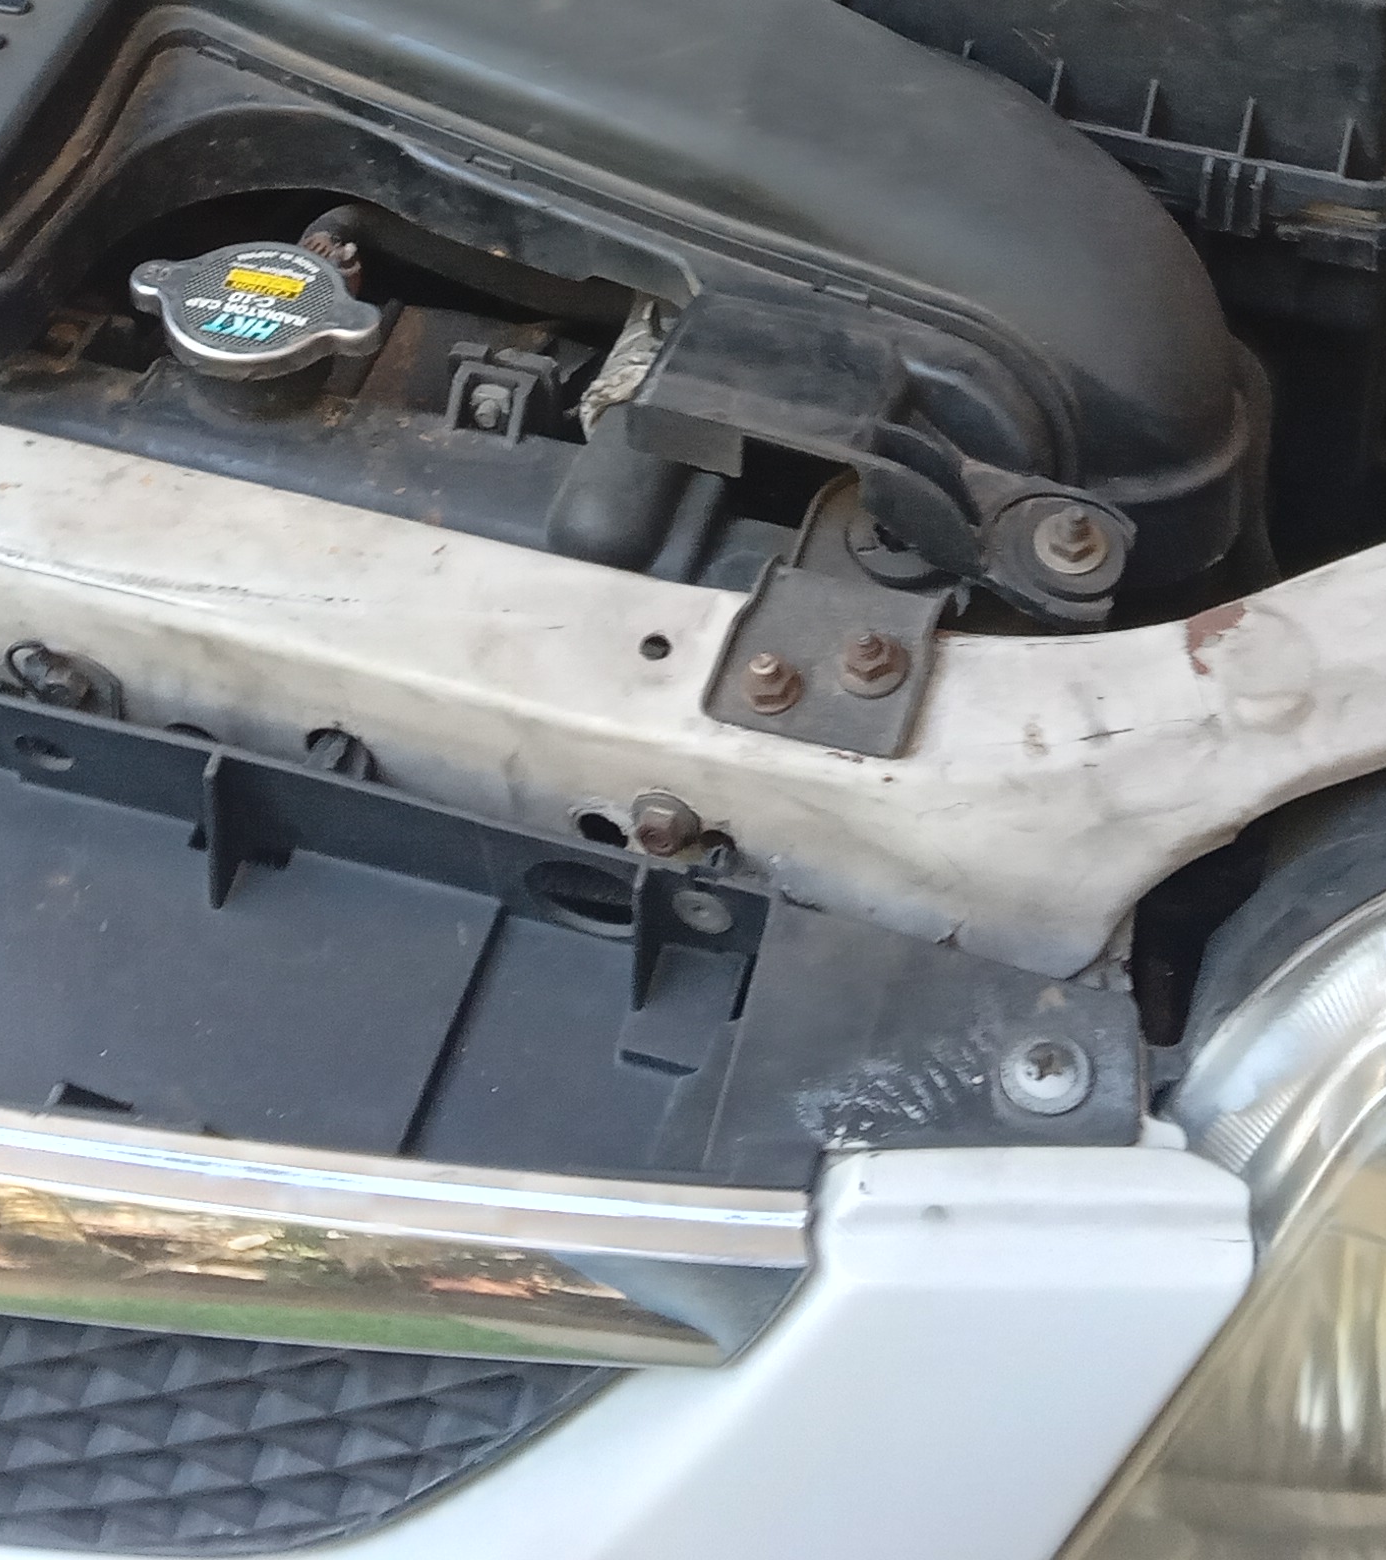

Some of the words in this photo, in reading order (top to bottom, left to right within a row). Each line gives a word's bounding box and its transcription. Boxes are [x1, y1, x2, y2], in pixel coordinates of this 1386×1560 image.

[184, 297, 223, 310] CAP
[222, 302, 309, 326] RADIATOR
[198, 313, 281, 342] HKT
